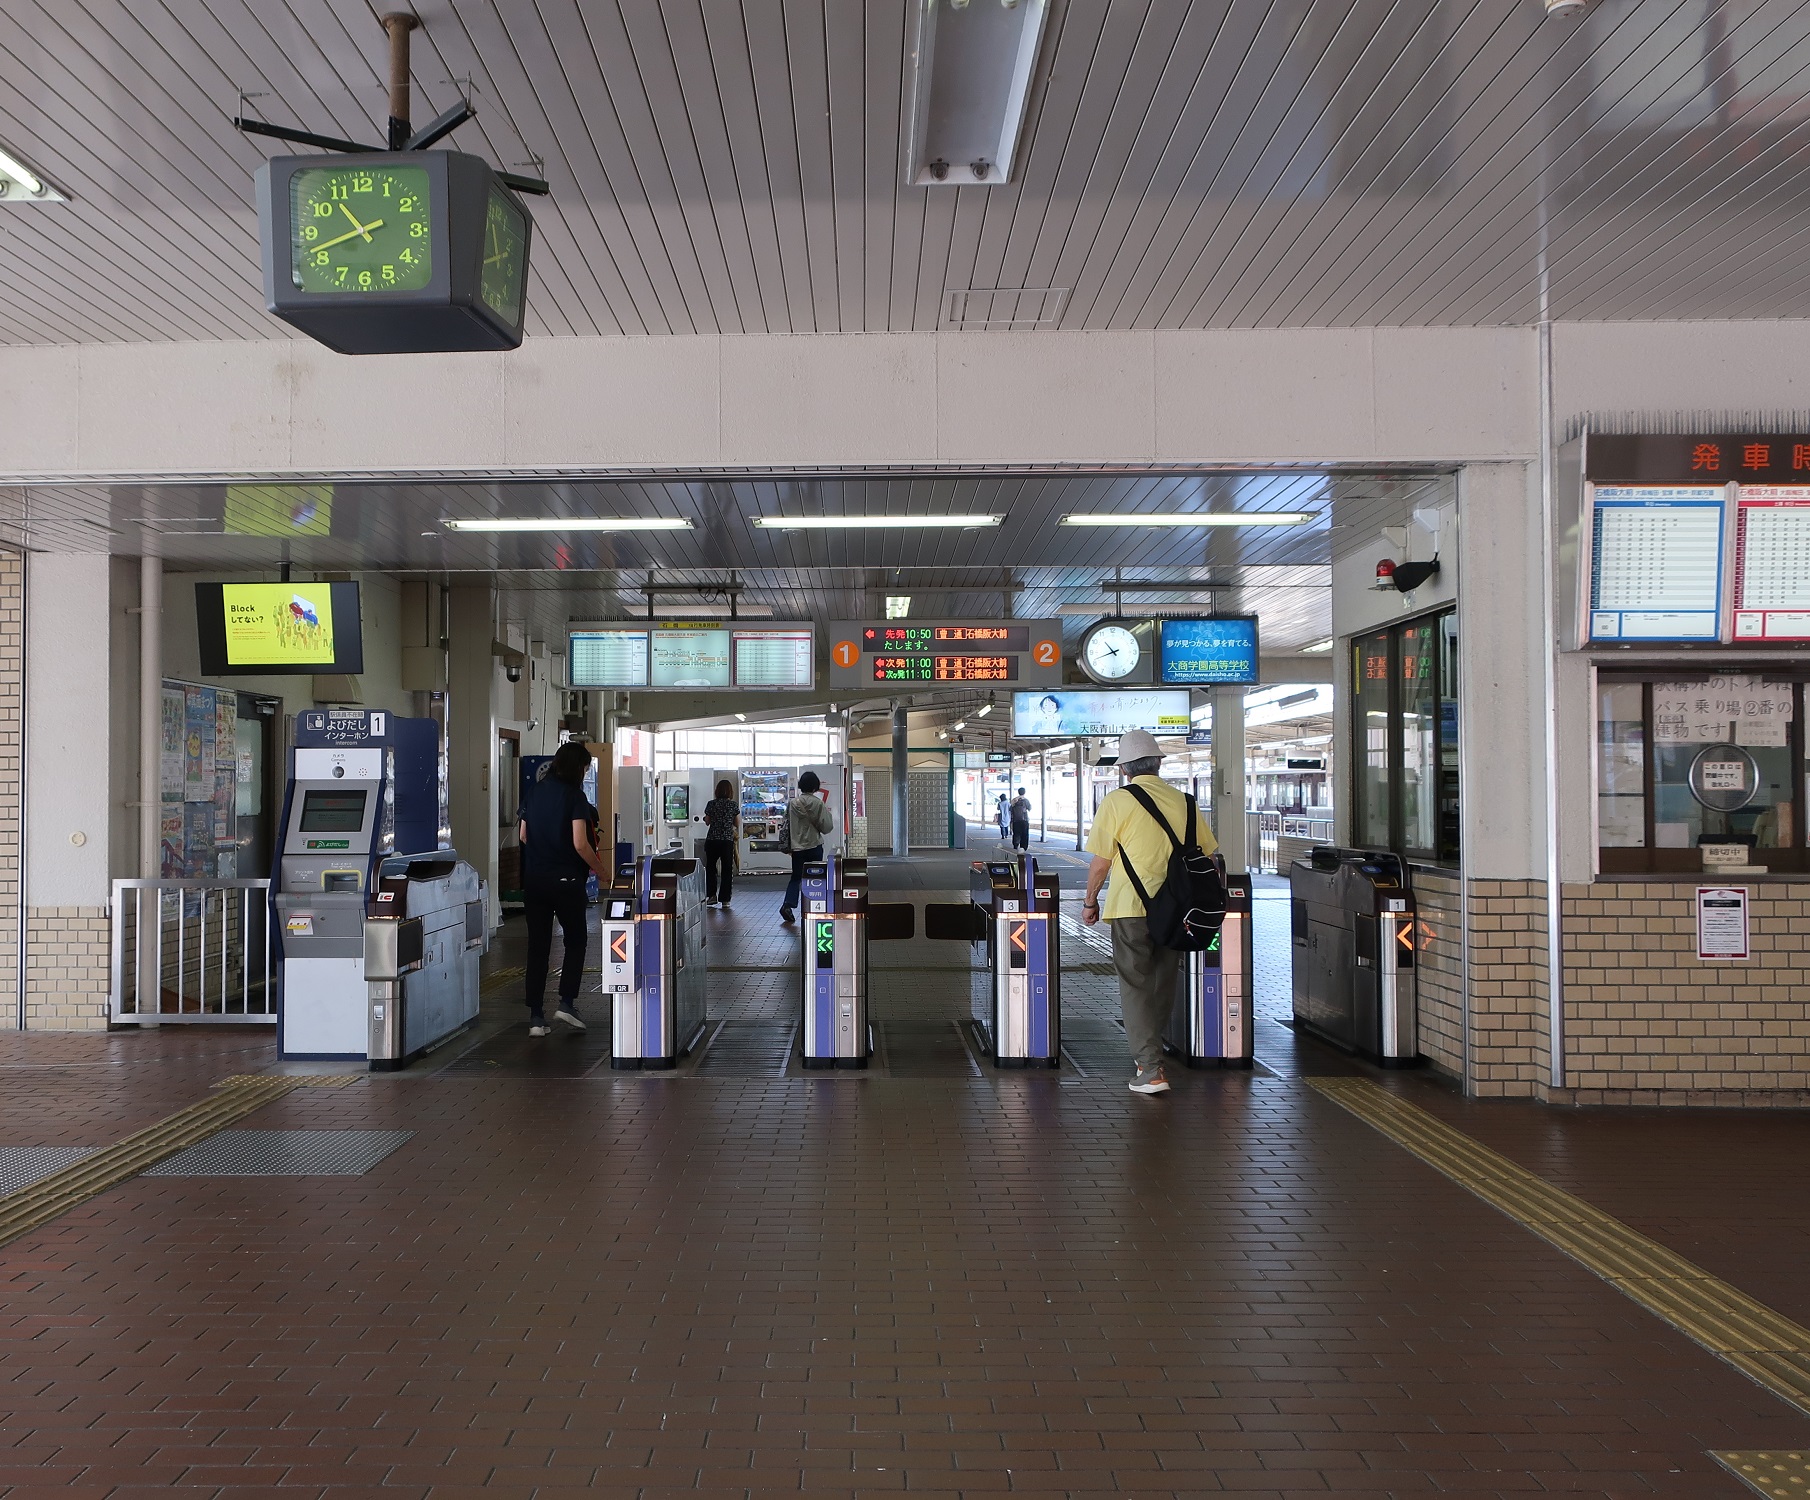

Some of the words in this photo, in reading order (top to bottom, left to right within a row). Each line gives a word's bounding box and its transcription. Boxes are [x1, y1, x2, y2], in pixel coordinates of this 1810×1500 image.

[352, 177, 373, 193] 12
[382, 182, 391, 197] 1
[331, 185, 348, 200] 11
[313, 203, 333, 217] 10
[399, 198, 413, 213] 2
[305, 226, 319, 240] 9
[410, 223, 424, 238] 3
[316, 251, 330, 265] 8
[399, 248, 413, 263] 4
[336, 266, 349, 281] 7
[358, 271, 371, 286] 6
[382, 265, 395, 279] 5
[1691, 443, 1810, 471] 発車時
[885, 629, 905, 639] 先発
[905, 629, 931, 639] 10:50
[966, 629, 1008, 639] 石橋阪大前
[884, 641, 929, 651] たします。
[1166, 639, 1252, 648] 夢が見つかる、夢を育てる。
[839, 645, 849, 664] 1
[1039, 643, 1054, 663] 2
[885, 658, 905, 668] 次発
[906, 658, 931, 668] 11:00
[966, 658, 1008, 668] 石橋阪大前
[1167, 660, 1250, 671] 大商学園高等学校
[906, 669, 931, 679] 11:10
[966, 669, 1008, 679] 石橋阪大前
[1655, 699, 1792, 716] バス乗り場②番の
[326, 720, 367, 730] よびだし
[374, 717, 380, 732] 1
[1655, 723, 1725, 738] 建物です
[324, 732, 369, 740] インターホン
[806, 879, 822, 887] IC
[815, 902, 821, 911] 4
[1007, 902, 1014, 911] 3
[1395, 901, 1400, 909] 1
[817, 922, 832, 938] IC
[615, 965, 622, 973] 5
